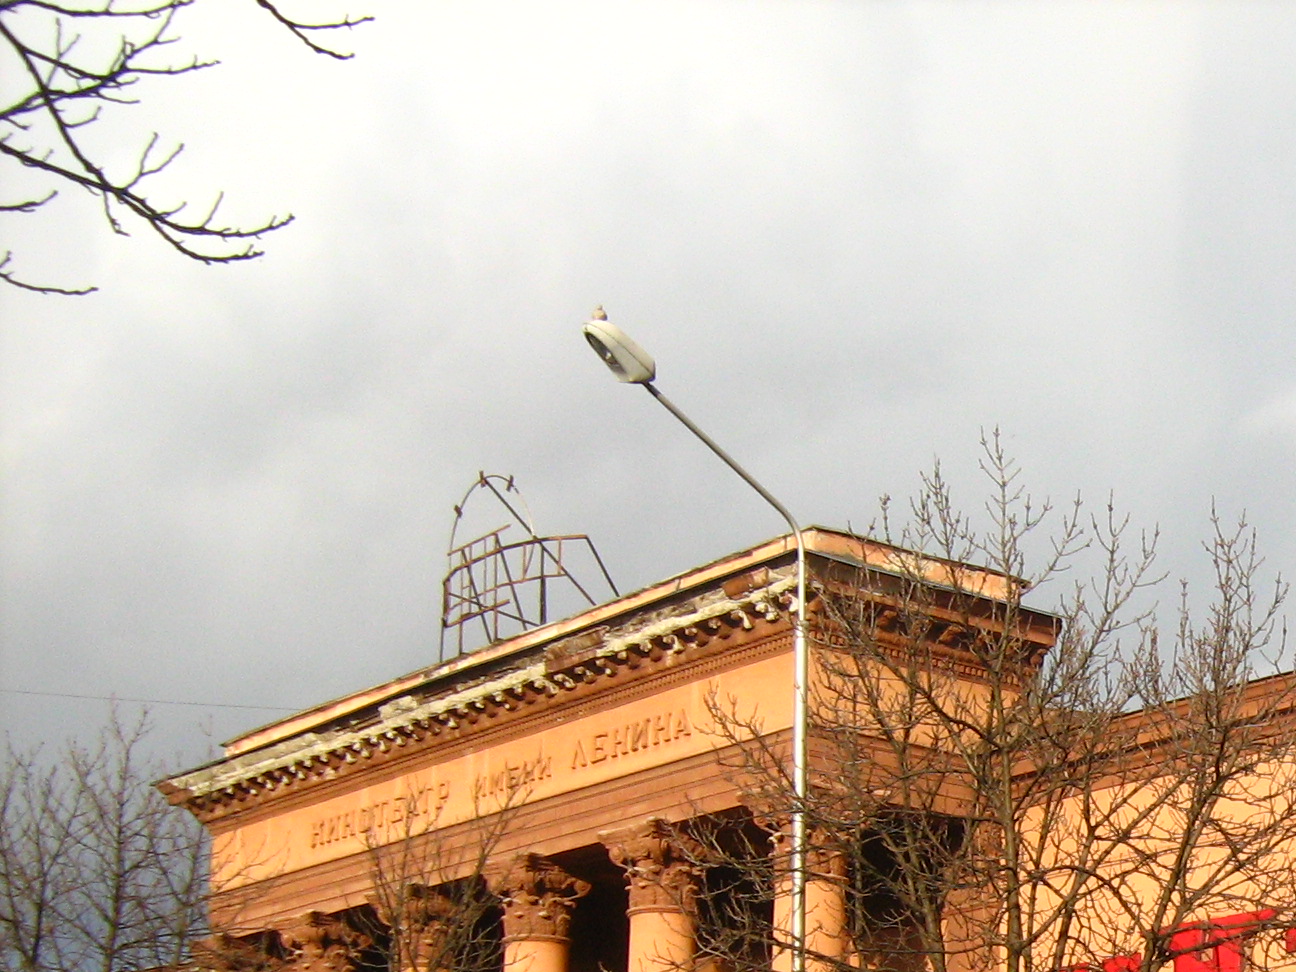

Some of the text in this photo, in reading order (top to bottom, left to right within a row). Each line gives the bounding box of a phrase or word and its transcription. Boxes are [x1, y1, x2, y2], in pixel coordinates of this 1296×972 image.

[311, 709, 692, 849] КИНОТЕАТР ИМЕНИ ЛЕНИНА
